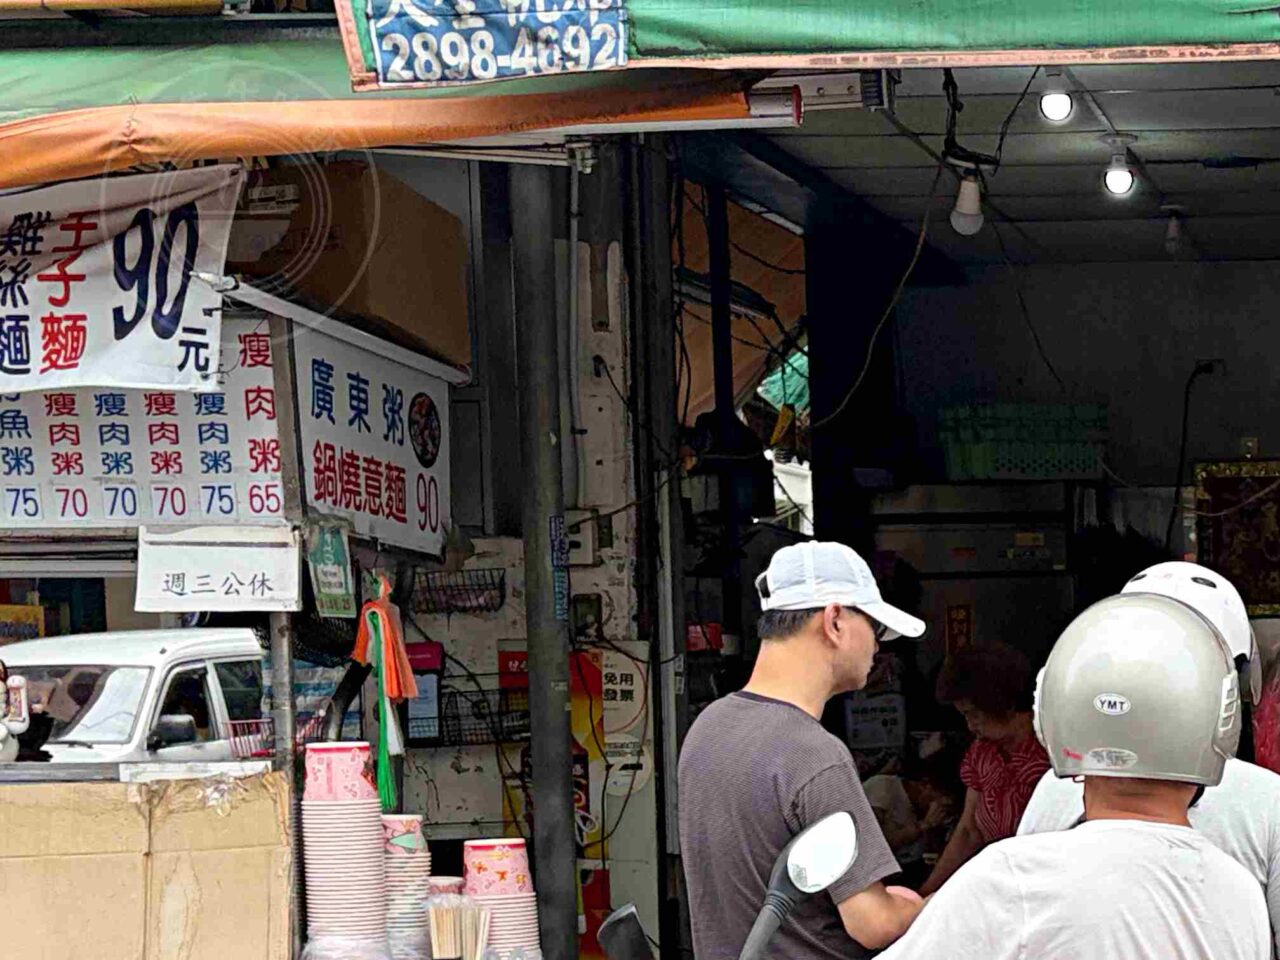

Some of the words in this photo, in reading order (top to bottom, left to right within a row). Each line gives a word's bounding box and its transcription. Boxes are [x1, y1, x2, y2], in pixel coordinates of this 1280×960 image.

[44, 392, 84, 476] 瘦肉粥
[93, 392, 134, 475] 瘦肉粥
[144, 391, 183, 475] 瘦肉粥
[194, 391, 233, 475] 瘦肉粥
[238, 332, 281, 474] 瘦肉粥
[311, 358, 405, 447] 廣東粥
[6, 488, 39, 517] 75
[55, 488, 88, 517] 70
[104, 487, 137, 517] 70
[153, 487, 186, 516] 70
[201, 485, 234, 515] 75
[248, 484, 281, 514] 65
[312, 439, 408, 523] 鍋燒意麵
[416, 472, 439, 534] 90
[162, 571, 274, 597] 週三公休
[1099, 699, 1127, 711] YMT
